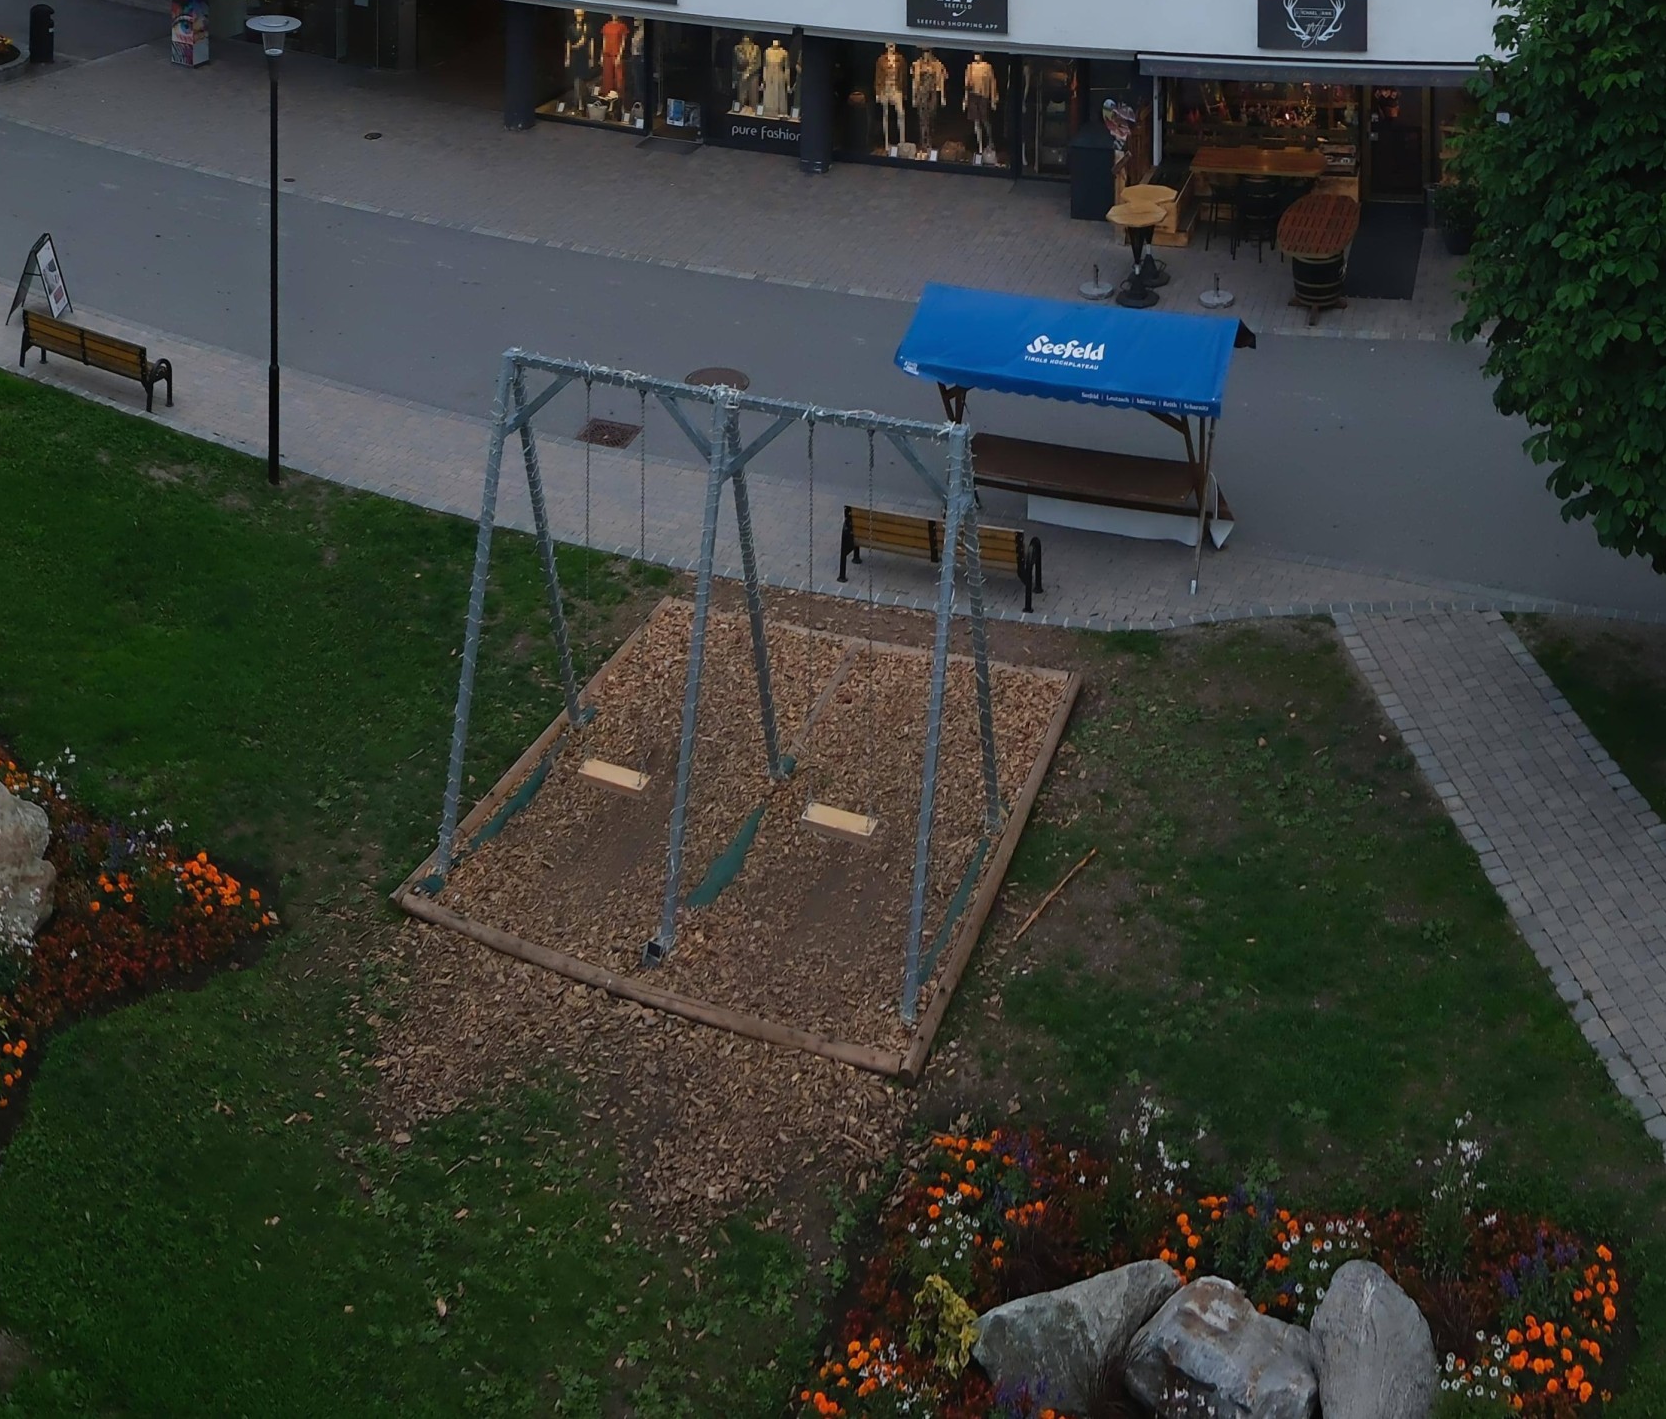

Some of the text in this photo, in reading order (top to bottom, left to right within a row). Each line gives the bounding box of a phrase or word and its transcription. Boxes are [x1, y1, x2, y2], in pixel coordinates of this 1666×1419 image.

[944, 2, 973, 10] SEEFELD
[917, 18, 946, 26] SEEFELD
[948, 21, 983, 29] SHOPPING
[731, 125, 757, 137] pure
[1026, 335, 1106, 361] Seefeld
